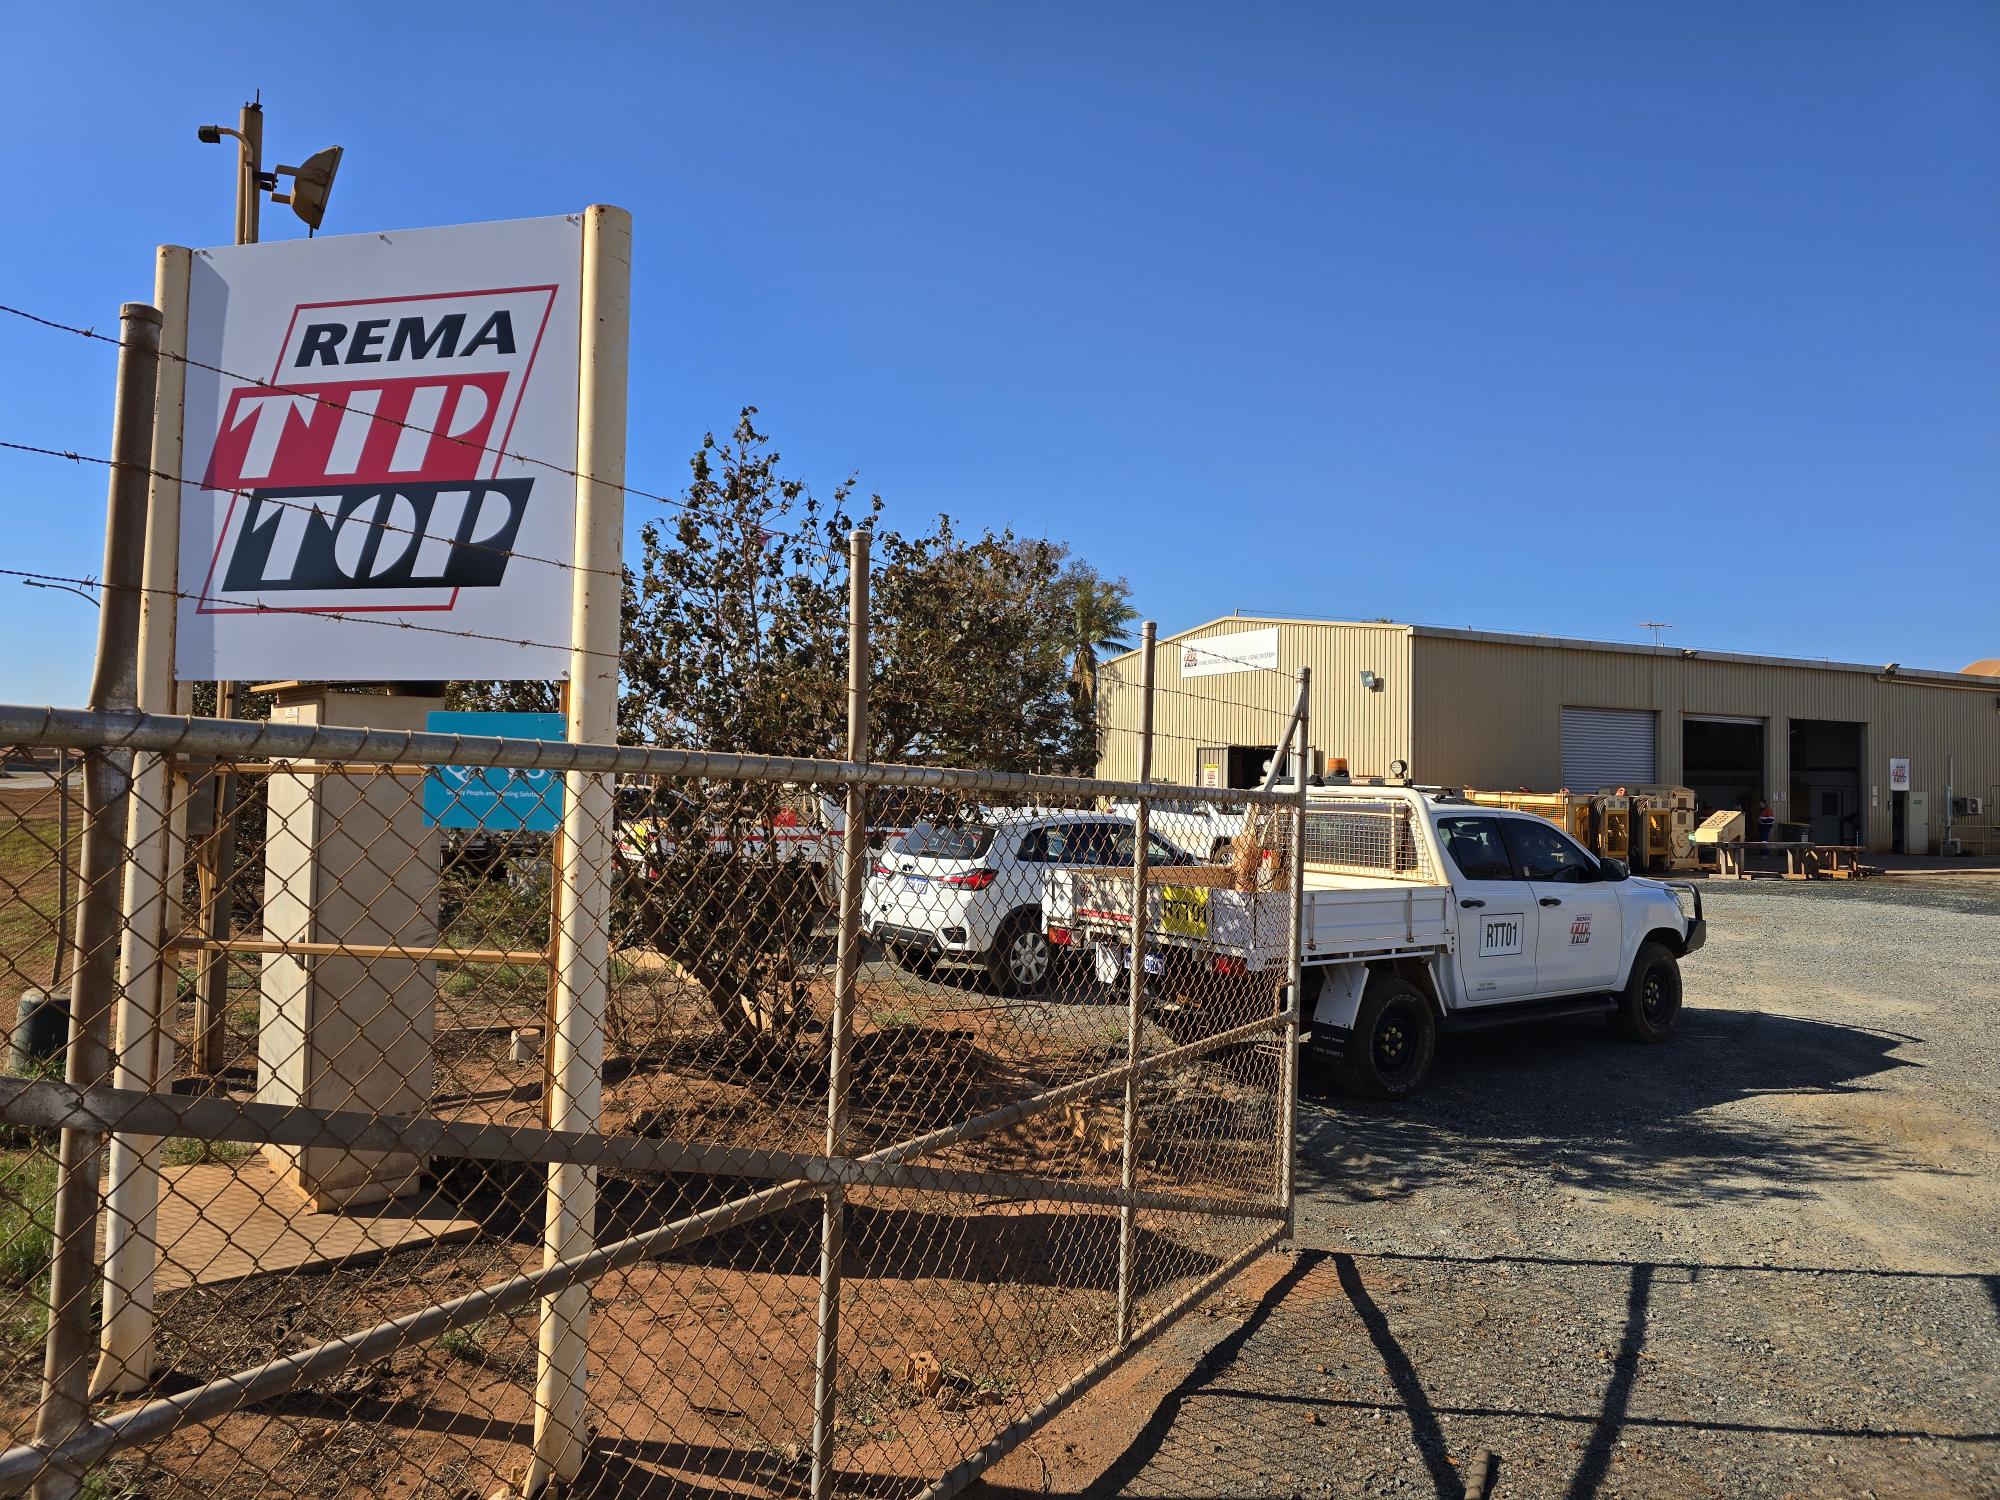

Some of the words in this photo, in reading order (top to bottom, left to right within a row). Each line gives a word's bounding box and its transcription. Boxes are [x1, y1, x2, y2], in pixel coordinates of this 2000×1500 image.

[294, 310, 516, 367] REMA
[229, 385, 489, 479] TIP
[251, 490, 513, 581] TOP
[1486, 922, 1518, 948] RTT01
